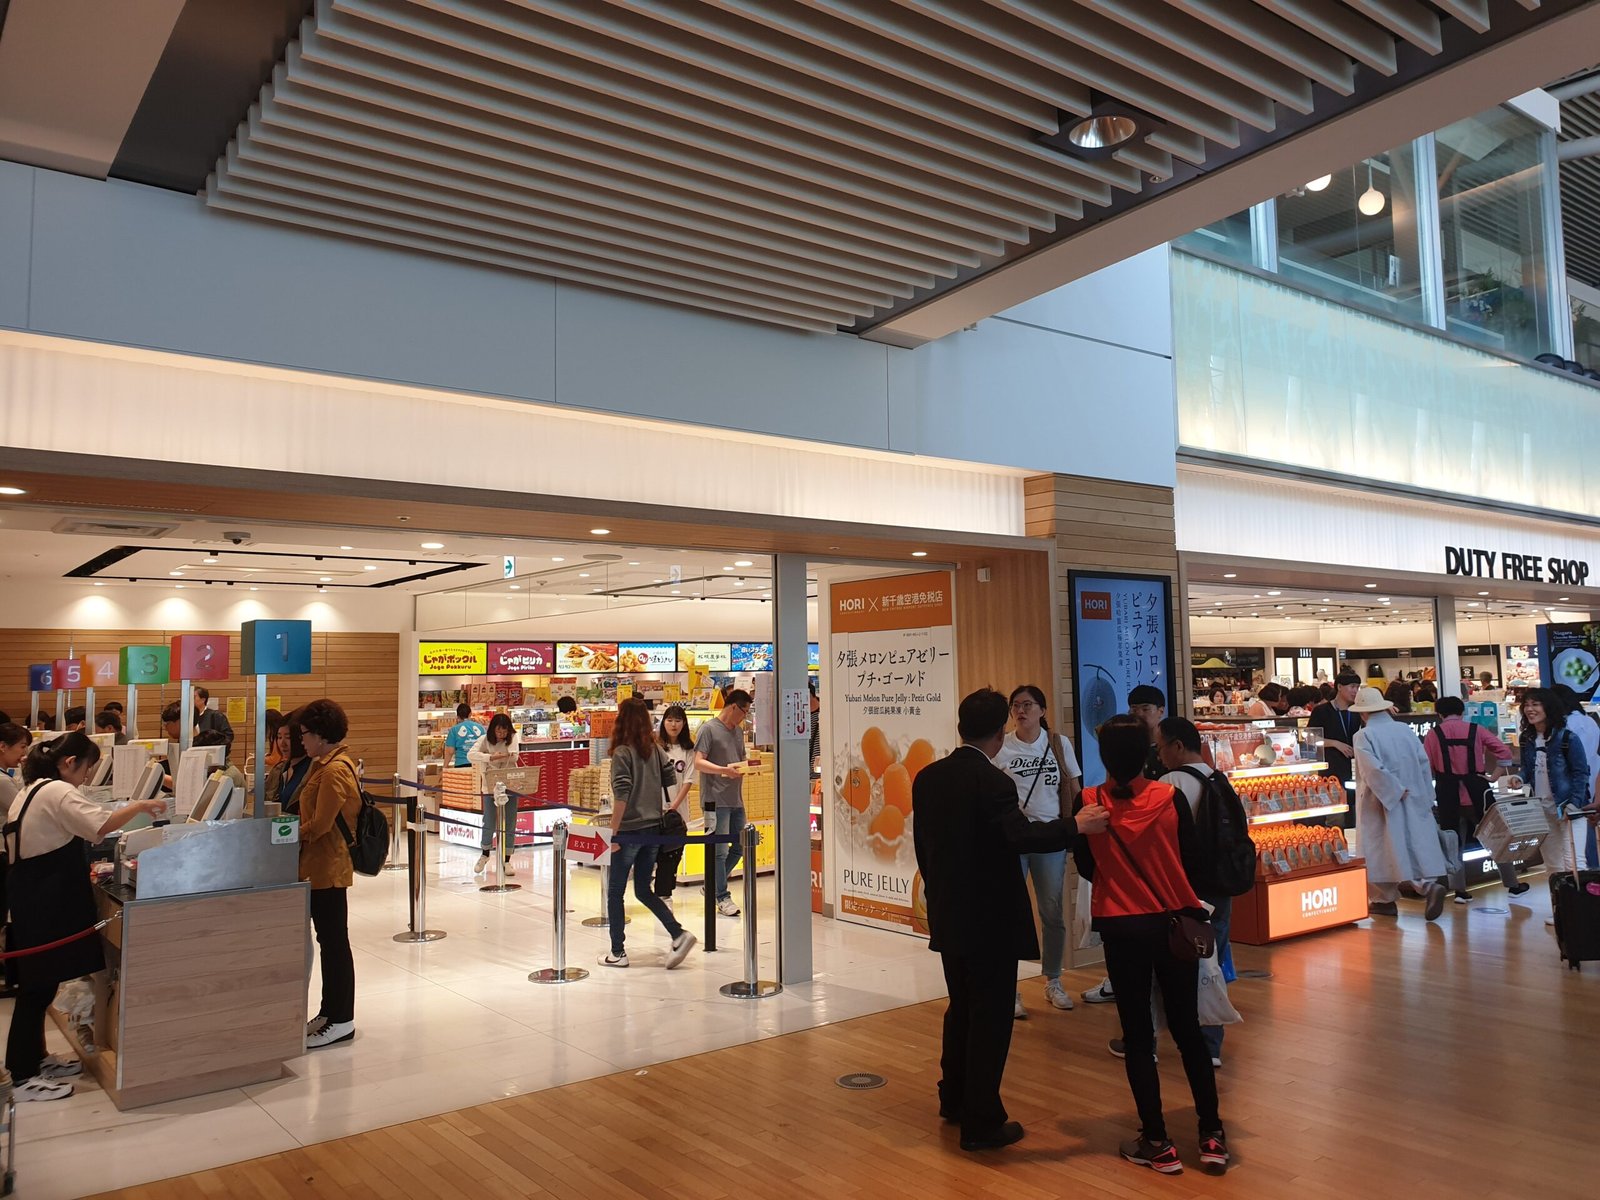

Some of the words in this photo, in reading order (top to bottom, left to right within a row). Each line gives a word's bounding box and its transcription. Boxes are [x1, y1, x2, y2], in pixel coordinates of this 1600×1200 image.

[1445, 546, 1496, 578] DUTY
[1502, 552, 1543, 582] FREE
[1548, 557, 1589, 586] SHOP
[840, 597, 865, 611] HORI
[882, 590, 943, 607] 新千歳空港免税店
[1085, 599, 1107, 609] HORI
[275, 632, 288, 662] 1
[1146, 593, 1159, 684] 夕張メロン
[141, 654, 158, 675] 3
[196, 644, 214, 670] 2
[423, 654, 477, 664] じゃがポックル
[500, 655, 542, 665] じゃがピリカ
[837, 646, 950, 669] 夕張メロンピュアゼリー
[41, 670, 52, 685] 6
[67, 665, 80, 682] 5
[97, 661, 113, 679] 4
[857, 670, 926, 688] プチ・ゴールド
[845, 693, 862, 702] Yubari
[863, 694, 880, 702] Melon
[882, 694, 894, 702] Pure
[895, 693, 907, 704] Jelly
[911, 693, 925, 702] Petit
[926, 693, 941, 702] Gold
[1010, 757, 1056, 769] Dickes
[1044, 774, 1058, 785] 22
[574, 840, 598, 850] EXIT
[843, 869, 873, 889] PURE
[877, 874, 909, 894] JELLY
[1301, 886, 1338, 912] HORI
